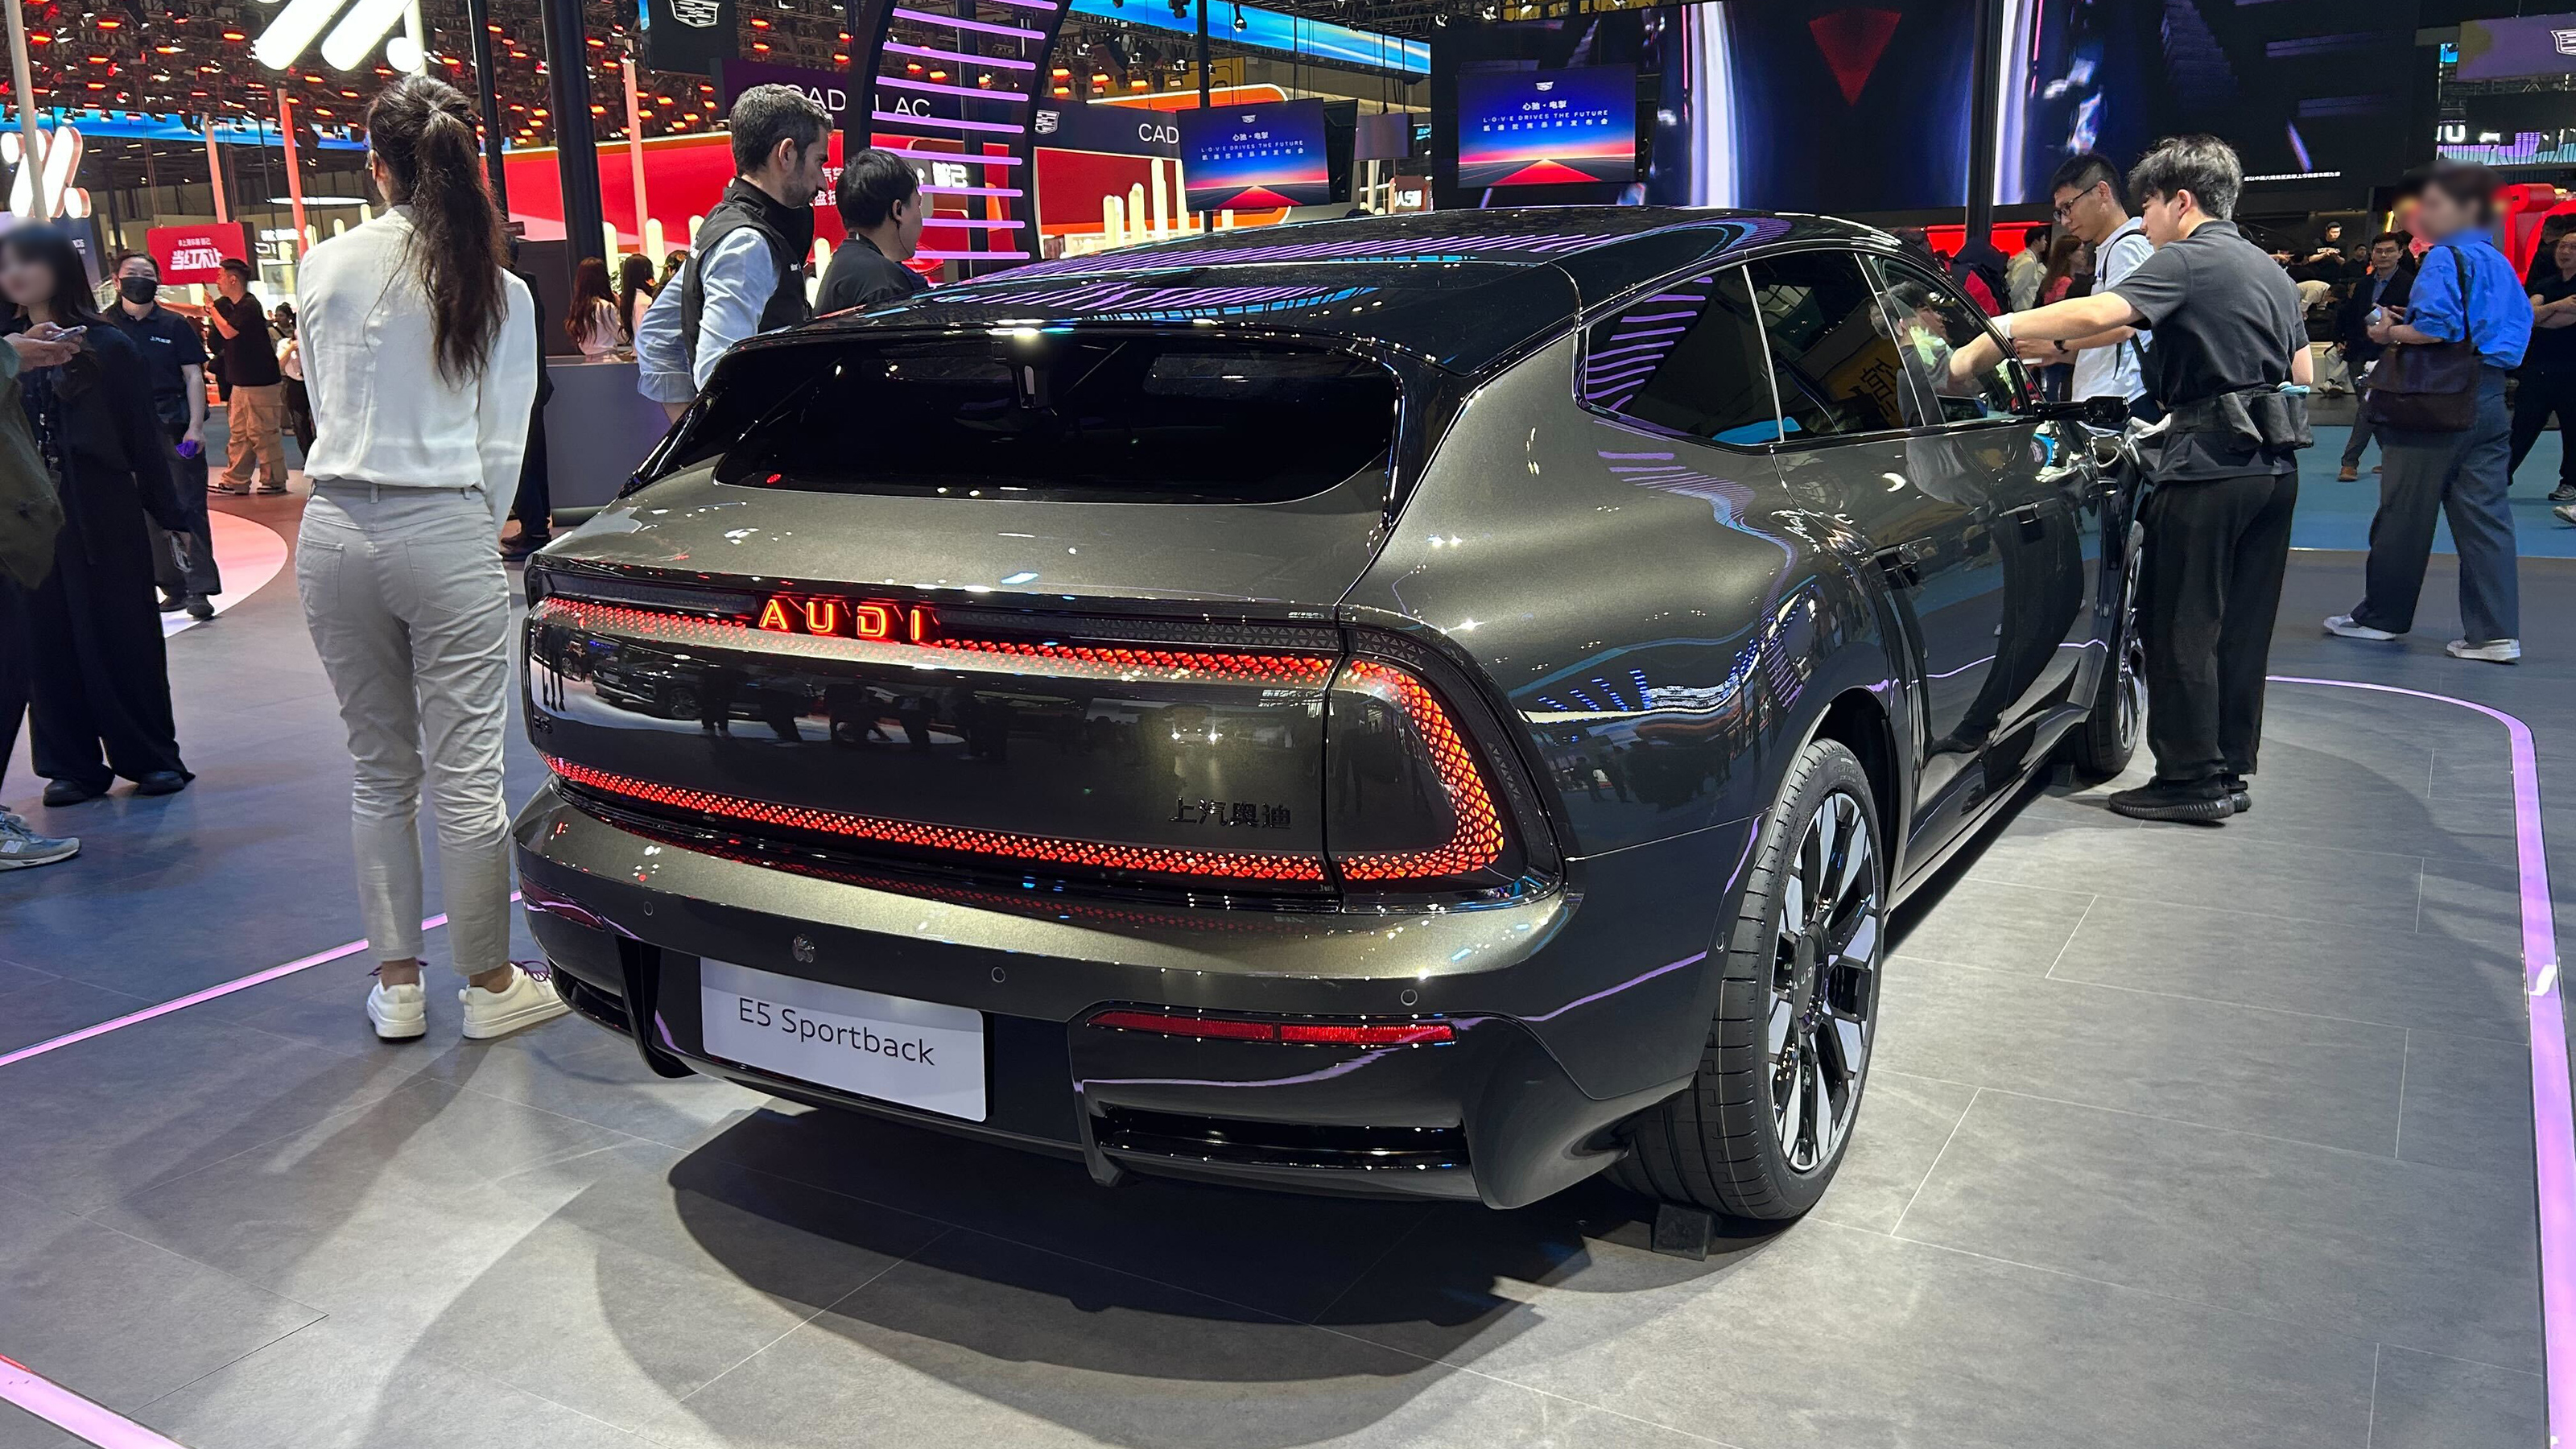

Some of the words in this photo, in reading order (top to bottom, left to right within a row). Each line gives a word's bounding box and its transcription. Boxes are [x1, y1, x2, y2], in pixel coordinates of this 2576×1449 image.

[786, 85, 931, 118] ADLAC
[1574, 109, 1608, 118] FUTURE
[758, 599, 920, 642] AUDI
[1168, 796, 1292, 830] 上汽奥迪
[739, 997, 772, 1027] E5
[782, 1008, 935, 1067] Sportback
